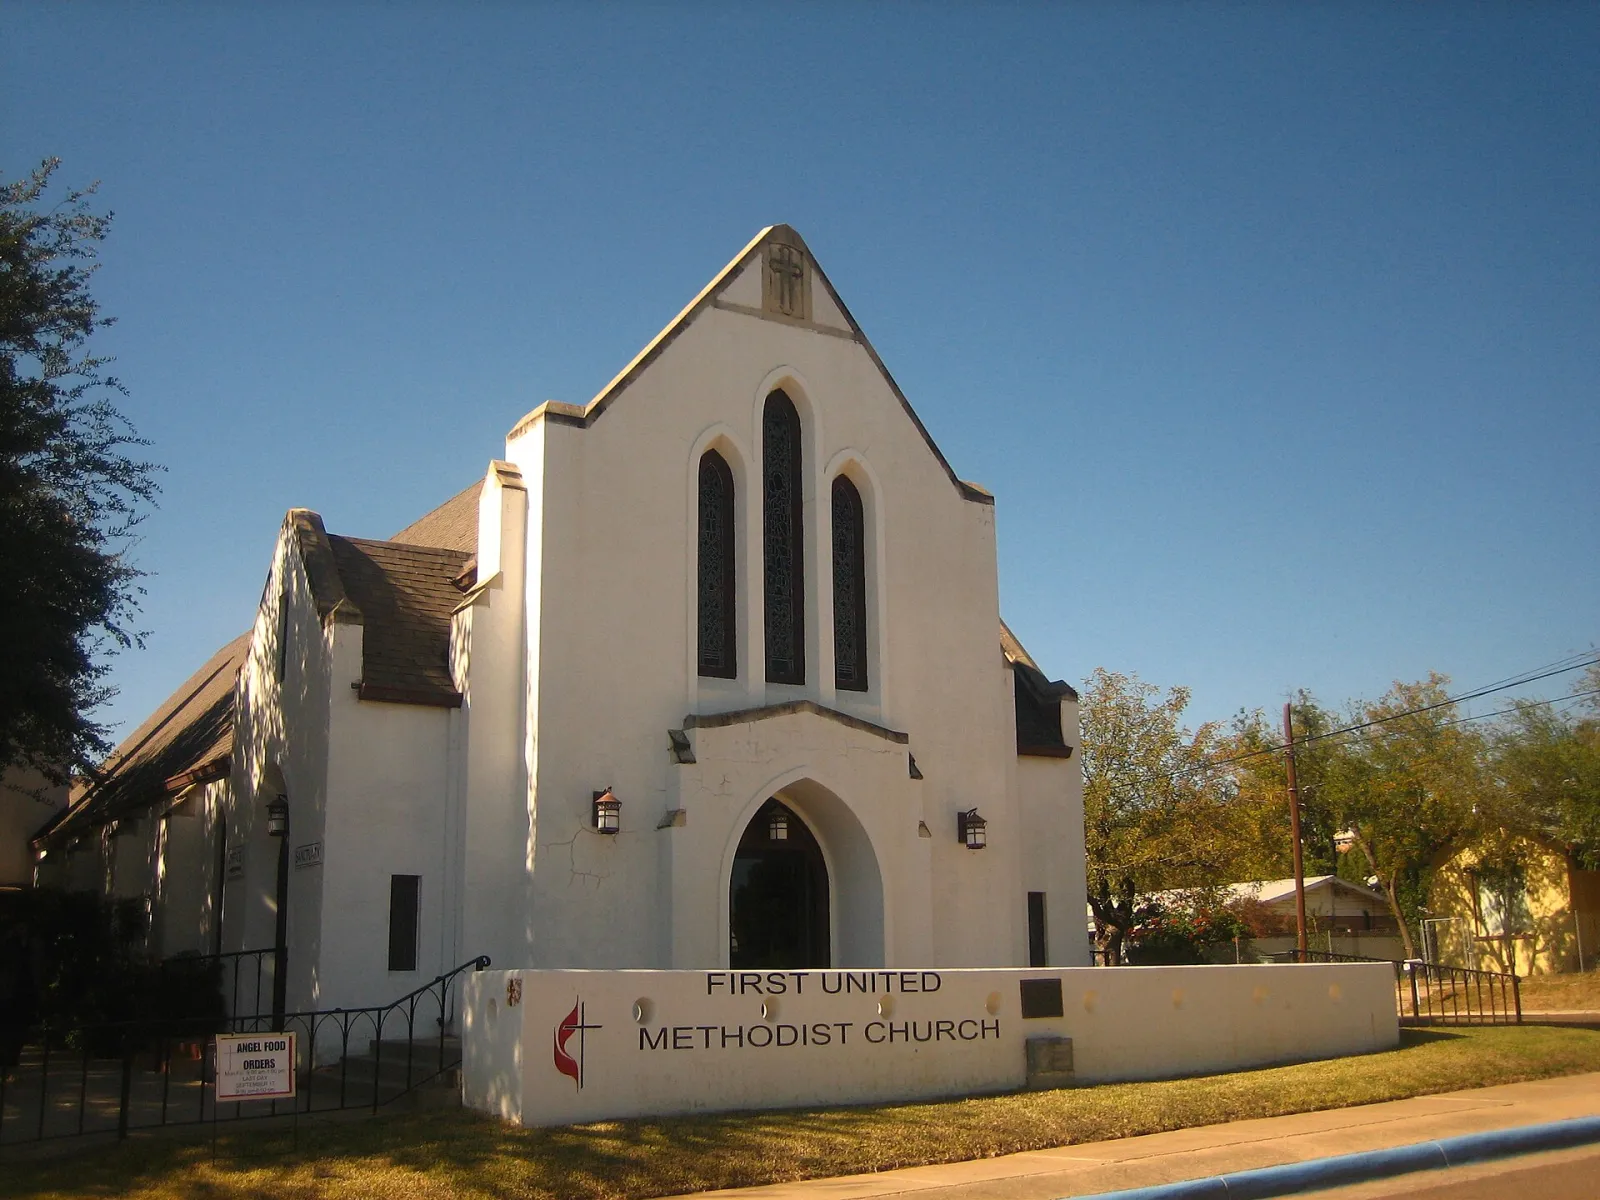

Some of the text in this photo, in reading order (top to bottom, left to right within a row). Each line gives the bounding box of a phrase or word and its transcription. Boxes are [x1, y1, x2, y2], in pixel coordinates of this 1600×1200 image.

[707, 972, 942, 995] FIRST UNITED
[639, 1019, 1000, 1050] METHODIST CHURCH
[237, 1041, 286, 1053] ANGEL FOOD
[243, 1059, 276, 1070] ORDERS
